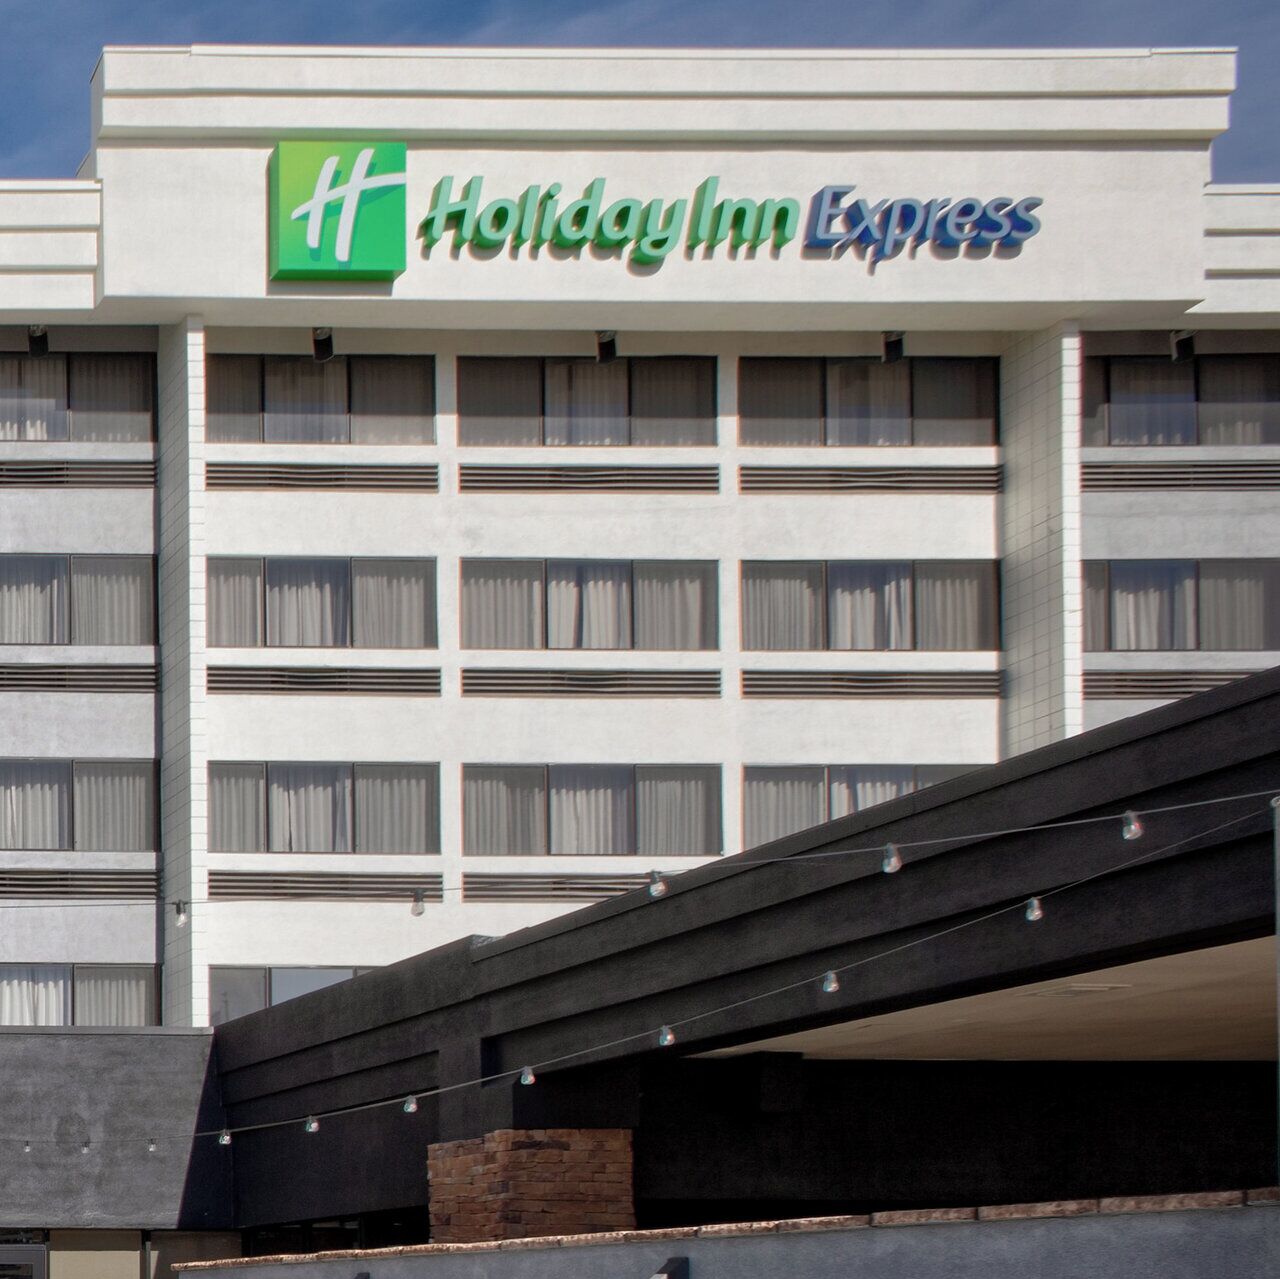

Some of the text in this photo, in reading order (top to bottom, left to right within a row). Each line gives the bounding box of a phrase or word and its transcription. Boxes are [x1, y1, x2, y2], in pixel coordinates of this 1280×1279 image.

[420, 175, 1044, 262] Holiday Inn Express
